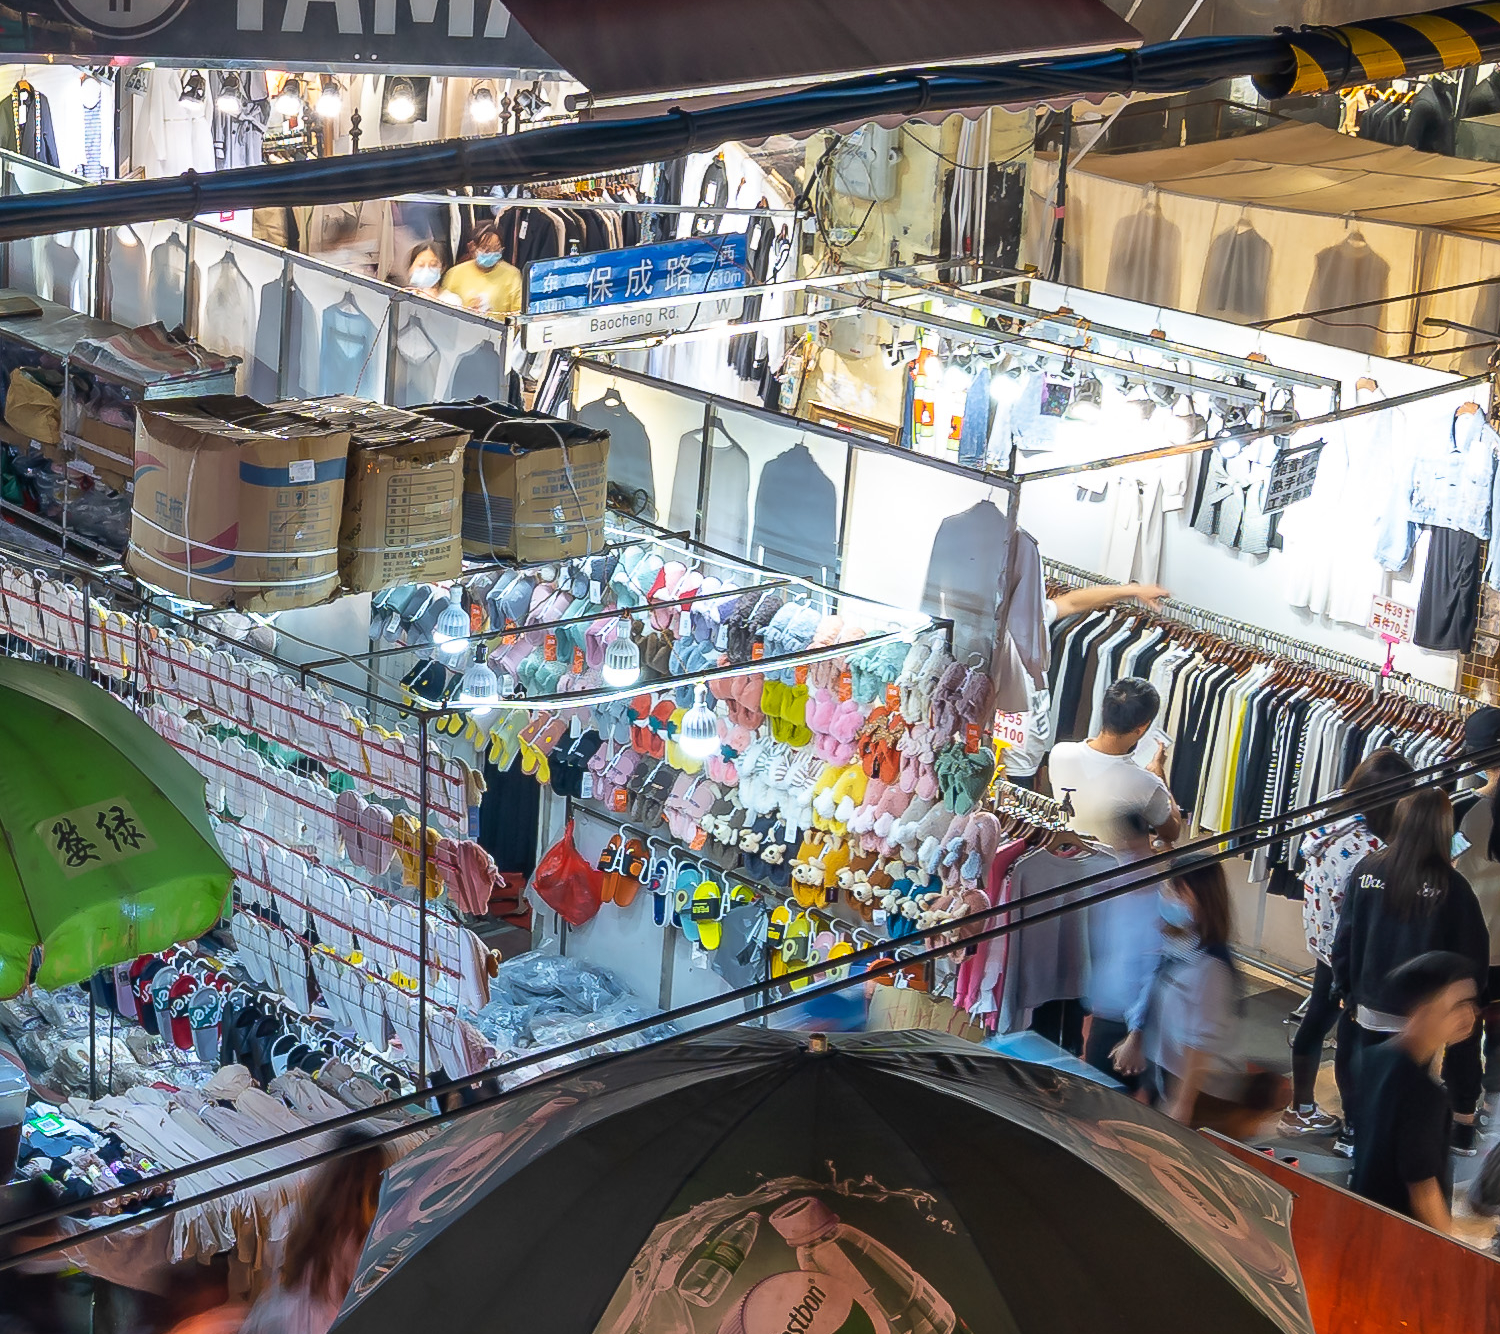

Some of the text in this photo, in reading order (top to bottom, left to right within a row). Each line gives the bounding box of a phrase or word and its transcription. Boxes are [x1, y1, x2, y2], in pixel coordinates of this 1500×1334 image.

[541, 244, 737, 304] 东 保成路 西
[541, 298, 732, 345] E Baocheng Rd. W
